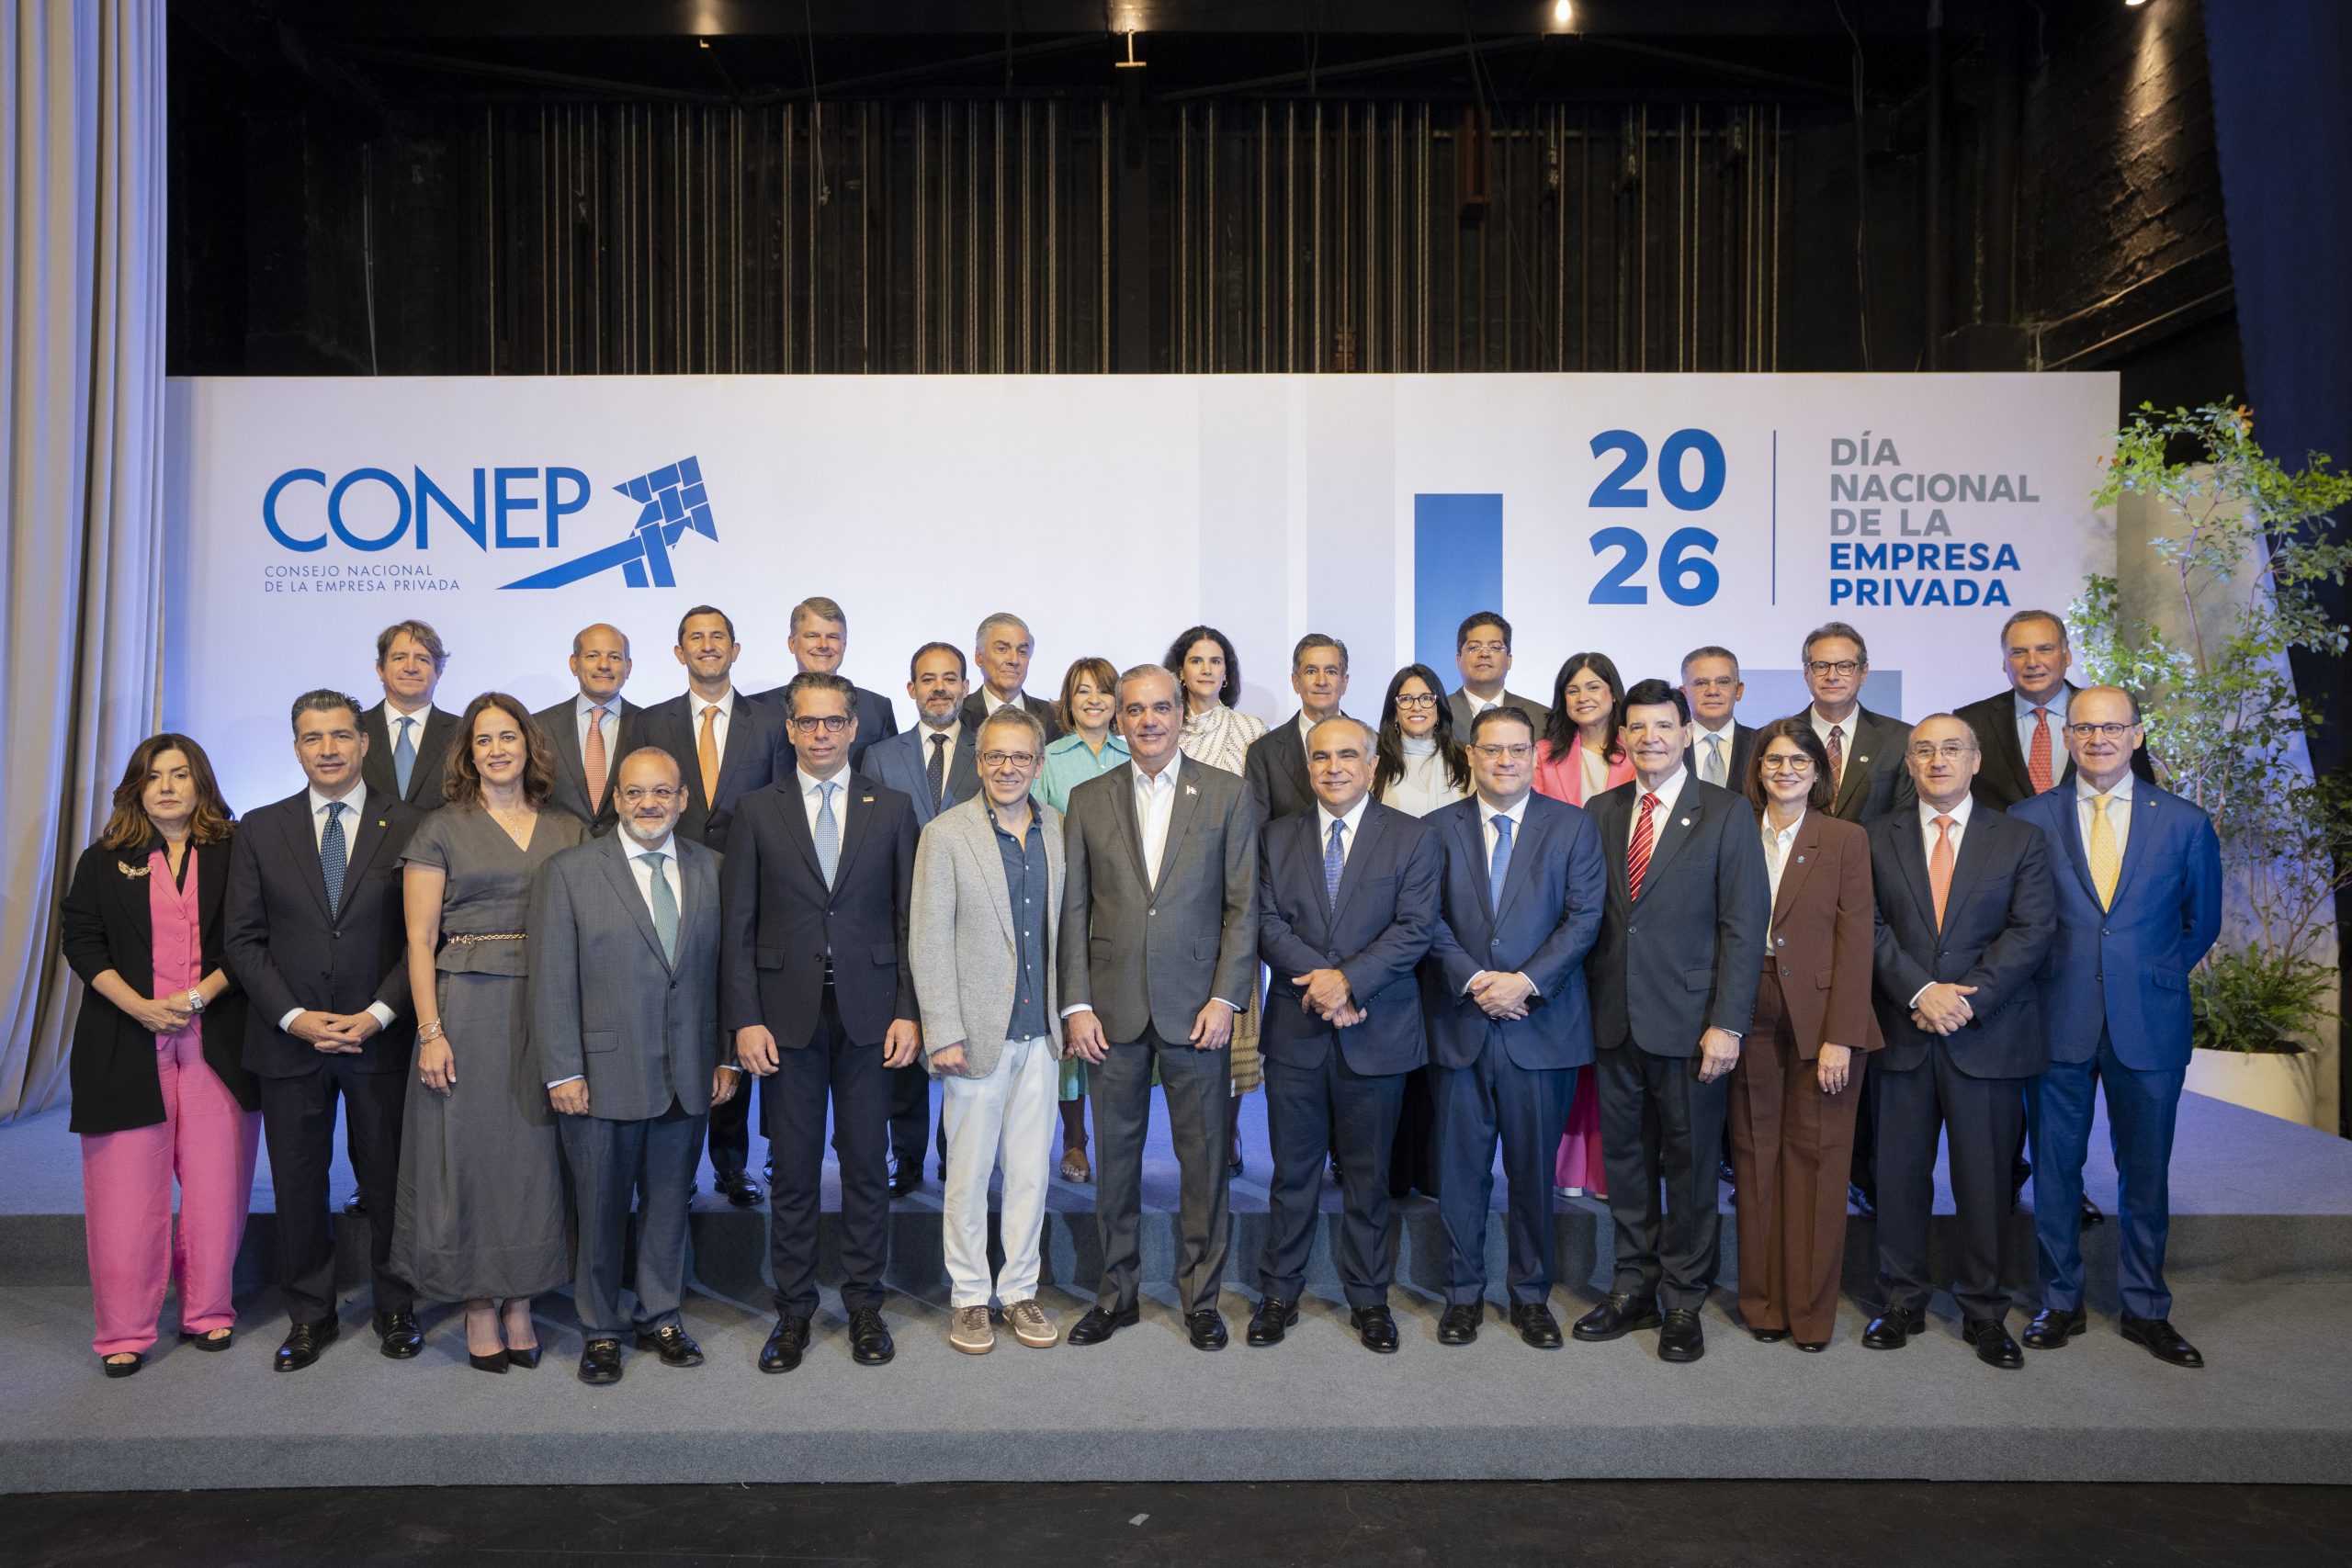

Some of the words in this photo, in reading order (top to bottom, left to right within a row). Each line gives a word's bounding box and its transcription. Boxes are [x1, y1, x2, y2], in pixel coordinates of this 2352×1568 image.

[1830, 431, 1902, 466] DÍA
[1588, 428, 1727, 512] 20
[1830, 473, 2040, 502] NACIONAL
[262, 464, 592, 553] CONEP
[1830, 509, 1882, 536] DE
[1900, 509, 1953, 536] LA
[264, 565, 340, 578] CONSEJO
[347, 564, 433, 577] NACIONAL
[1588, 526, 1721, 606] 26
[1830, 542, 2022, 571] EMPRESA
[265, 581, 284, 592] DE
[289, 581, 309, 592] LA
[316, 580, 387, 592] EMPRESA
[393, 579, 460, 592] PRIVADA
[1830, 578, 2012, 607] PRIVADA
